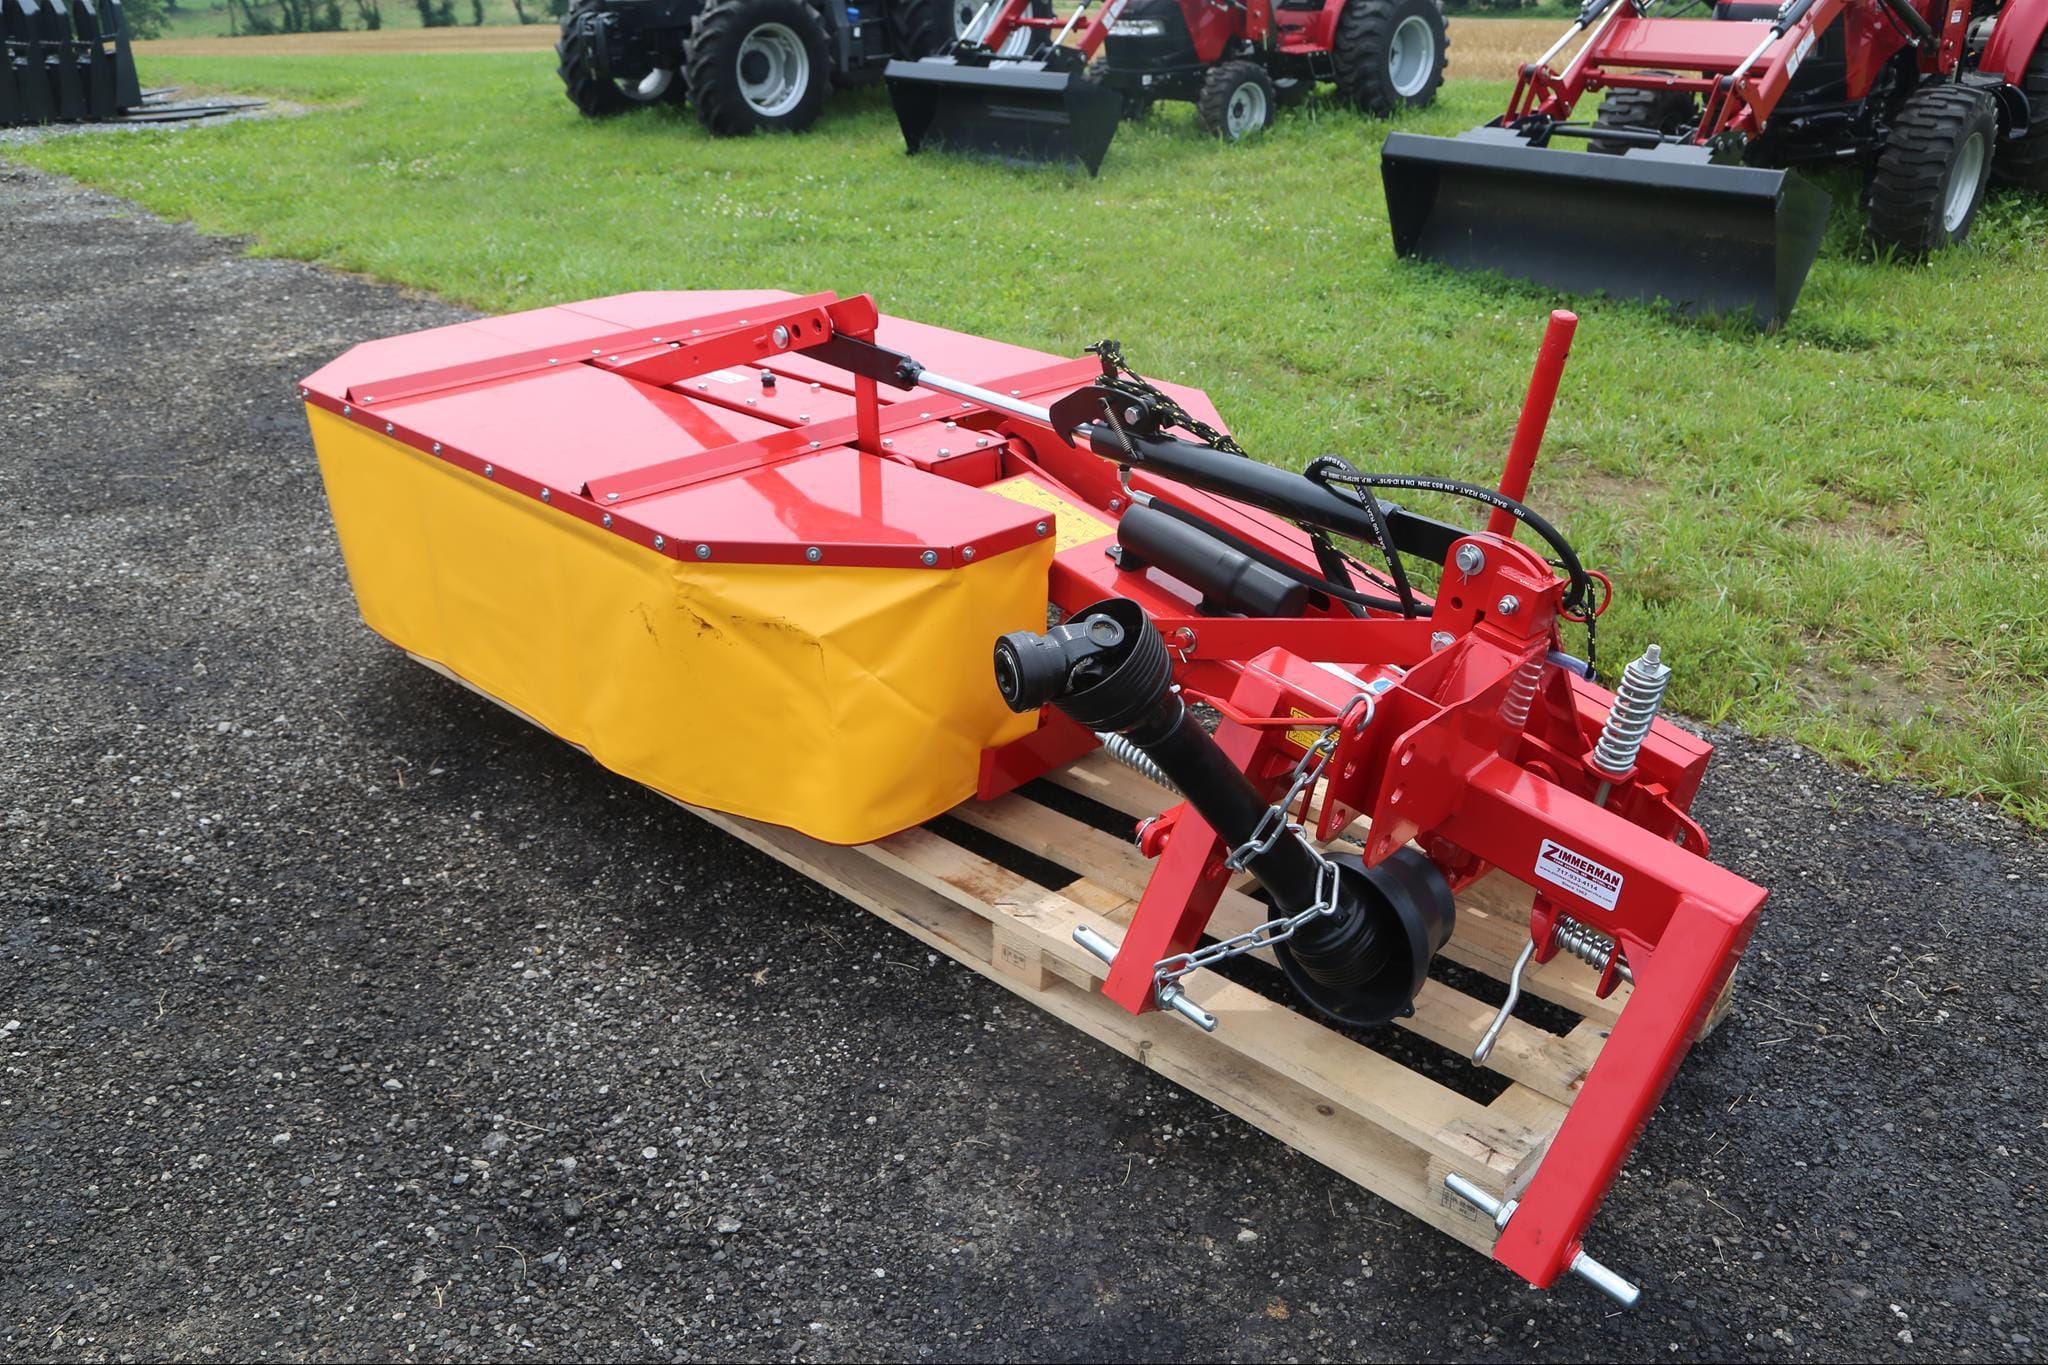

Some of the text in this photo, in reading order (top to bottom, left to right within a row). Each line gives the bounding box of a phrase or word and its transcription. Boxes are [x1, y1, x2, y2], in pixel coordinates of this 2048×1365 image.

[1459, 487, 1479, 497] R2AT
[1479, 492, 1491, 501] 100
[1492, 498, 1508, 508] SAE
[1372, 522, 1381, 535] 100
[1377, 535, 1387, 550] SAE
[1542, 844, 1620, 886] ZIMMERMAN
